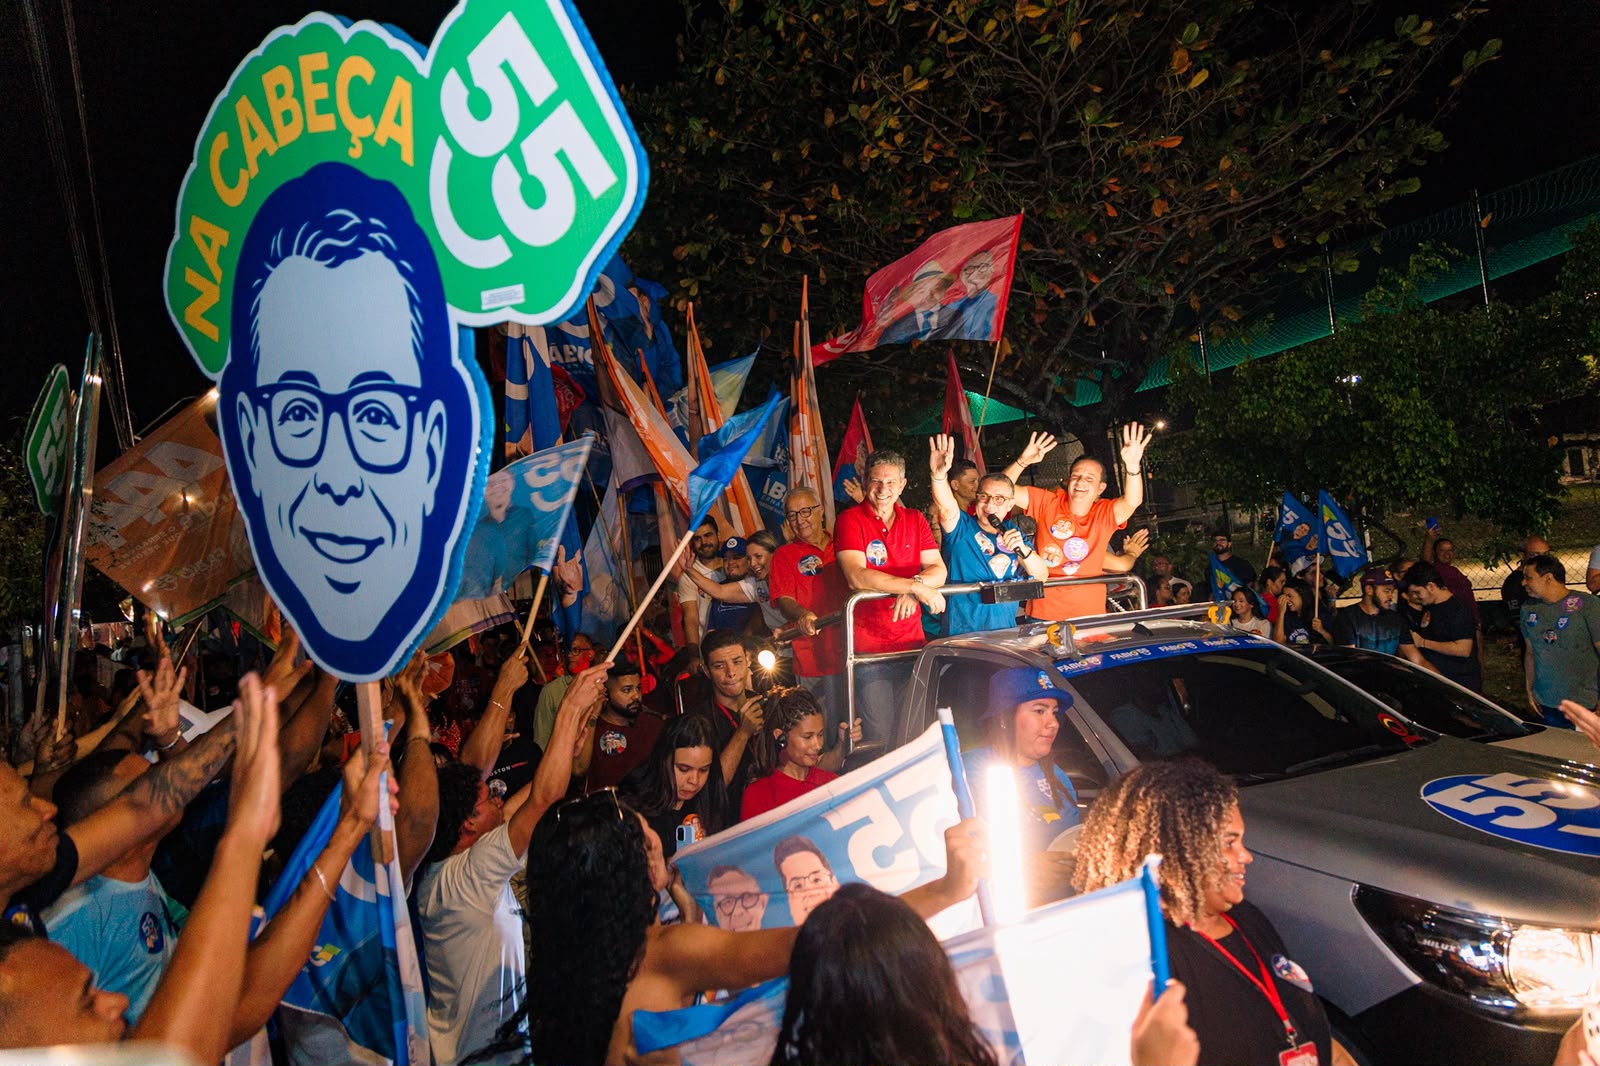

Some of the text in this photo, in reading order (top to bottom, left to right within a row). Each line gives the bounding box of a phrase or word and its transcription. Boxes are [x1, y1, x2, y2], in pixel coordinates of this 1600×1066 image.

[439, 10, 619, 248] 55
[184, 51, 414, 343] NA CABEÇA
[549, 341, 595, 366] ÁBIO
[1424, 772, 1600, 830] 55
[1422, 938, 1460, 952] HILUX
